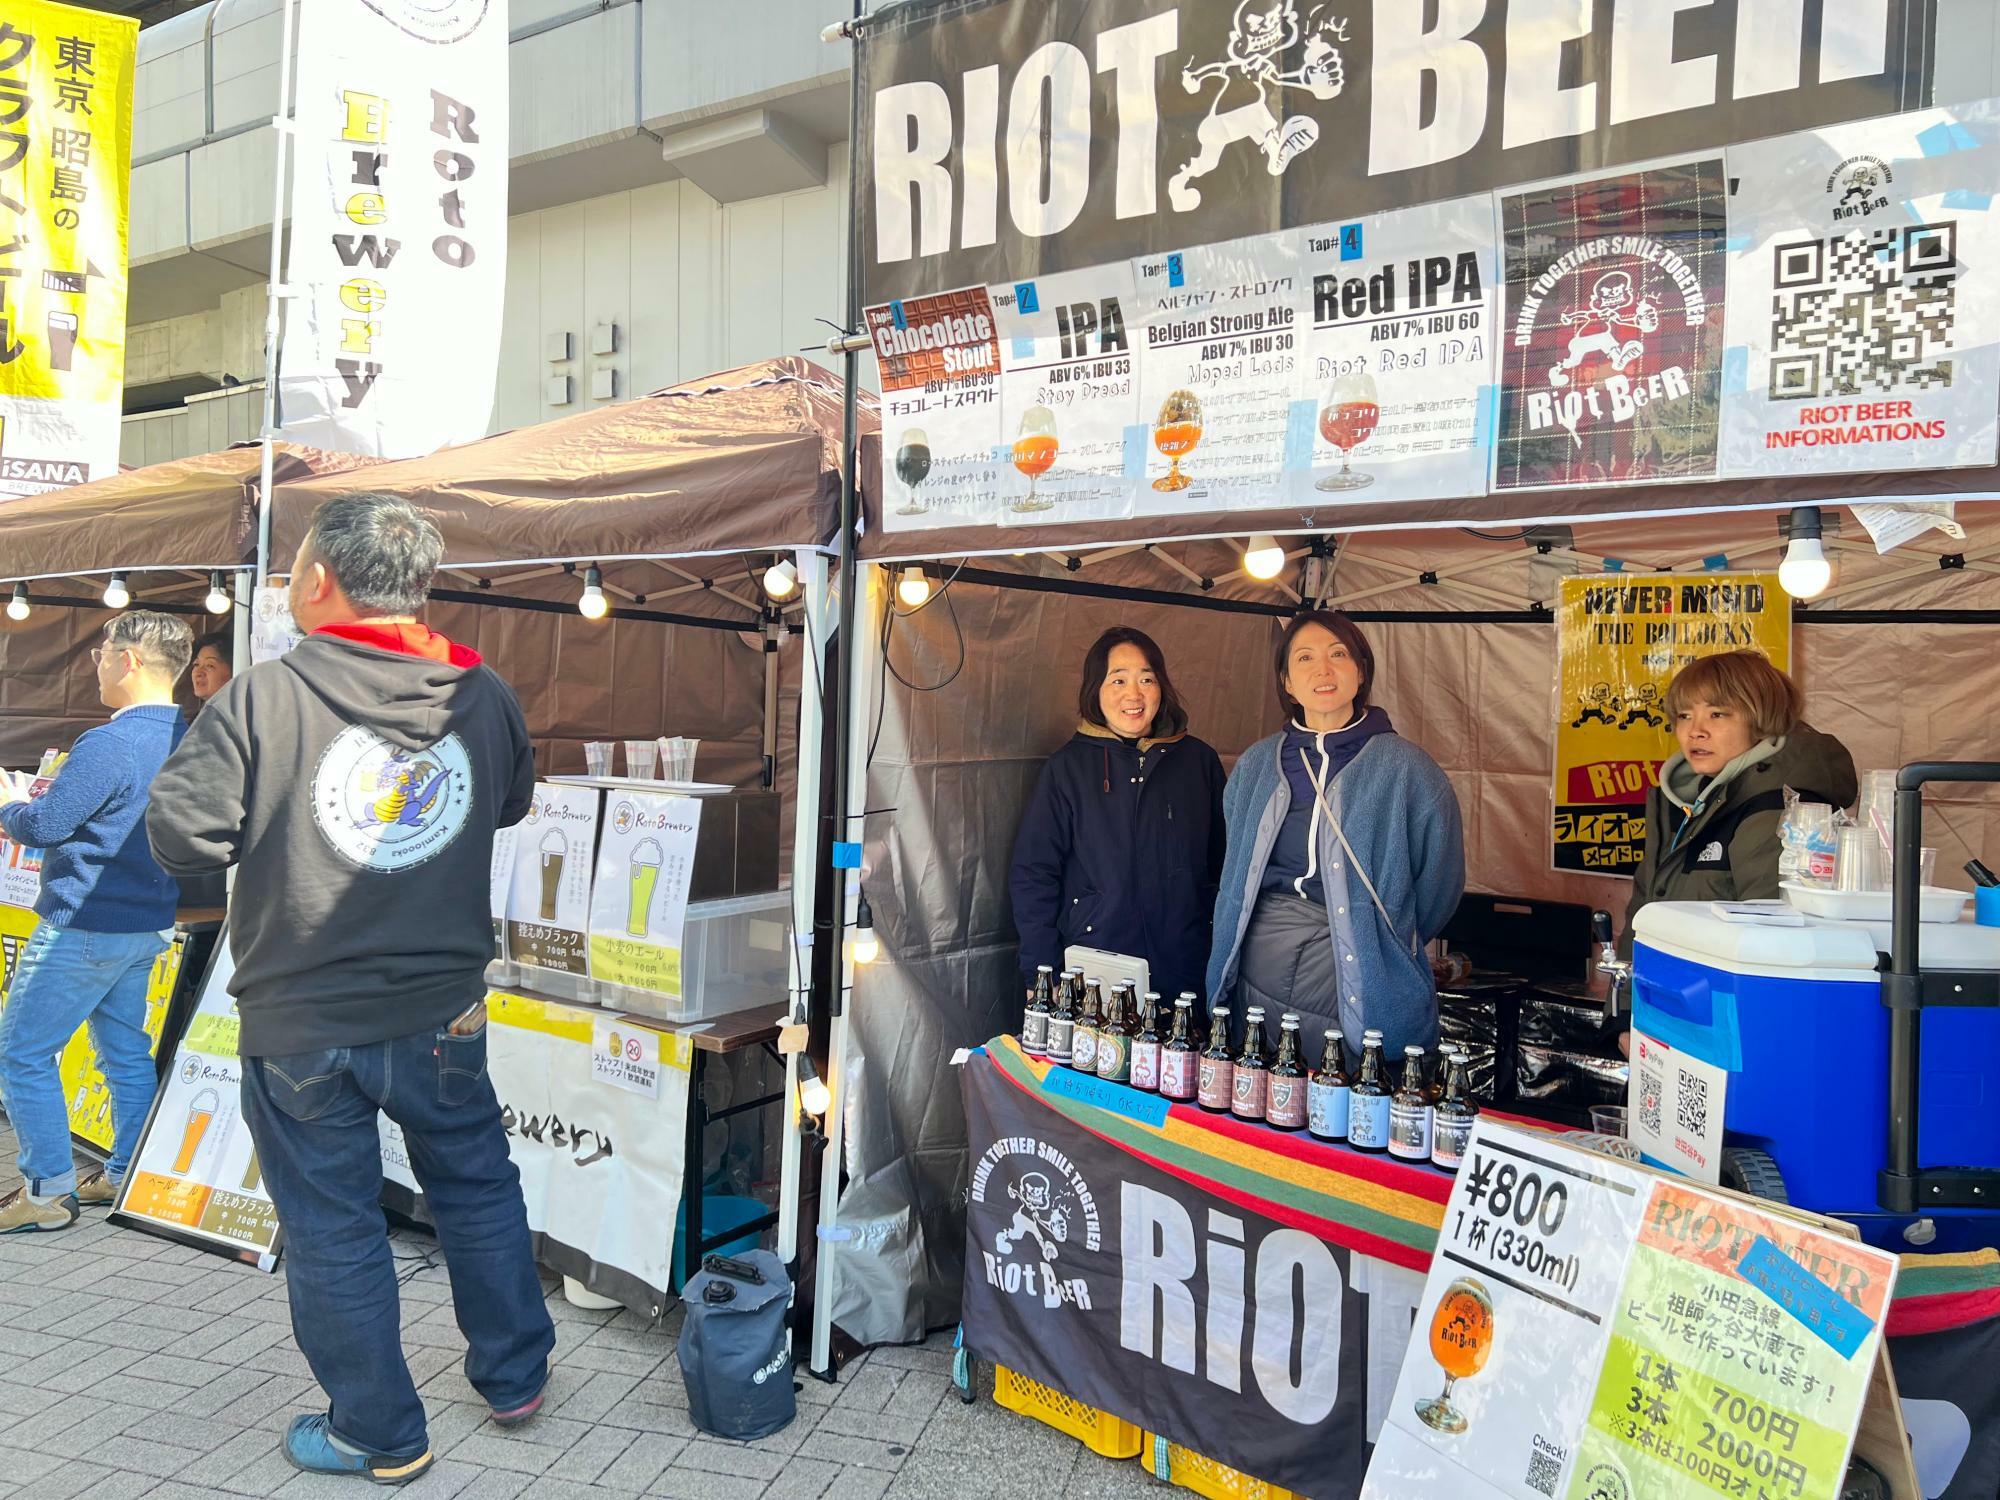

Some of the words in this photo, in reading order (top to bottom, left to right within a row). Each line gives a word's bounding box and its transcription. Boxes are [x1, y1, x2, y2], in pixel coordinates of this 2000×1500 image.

[53, 35, 96, 116] 東京
[875, 9, 1178, 264] RIOT
[50, 126, 91, 230] 昭島の
[429, 88, 480, 269] Roto
[1313, 264, 1395, 323] Red
[1407, 251, 1483, 309] IPA
[1514, 297, 1543, 347] DRINK
[1531, 238, 1610, 296] TOGETHER
[1611, 236, 1663, 263] SMILE
[1658, 248, 1705, 326] TOGETHER
[876, 313, 991, 357] Chocolate
[1055, 296, 1129, 359] IPA
[1148, 319, 1208, 344] Belgian
[1210, 311, 1264, 336] Strong
[1267, 307, 1294, 326] Ale
[1370, 323, 1401, 342] ABV
[1403, 318, 1424, 337] 7%
[1427, 315, 1455, 335] IBU
[1458, 311, 1480, 329] 60
[942, 342, 994, 373] Stout
[1201, 344, 1227, 361] ABV
[1229, 341, 1247, 357] 7%
[1249, 337, 1273, 353] IBU
[1276, 333, 1294, 350] 30
[1315, 355, 1367, 380] Riot
[1379, 347, 1427, 373] Red
[1439, 335, 1484, 365] IPA
[924, 378, 943, 394] ABV
[960, 374, 978, 389] IBU
[980, 371, 994, 386] 30
[1049, 367, 1072, 384] ABV
[1073, 365, 1091, 381] 6%
[1092, 363, 1113, 379] IBU
[1115, 360, 1131, 375] 33
[1187, 362, 1243, 388] Moped
[889, 390, 999, 416] チョコレートスタウト
[1081, 379, 1131, 400] Dread
[1799, 404, 1854, 426] RIOT
[1856, 400, 1913, 421] BEER
[1765, 419, 1946, 449] INFORMATIONS
[1585, 585, 1673, 615] NEVER
[1681, 584, 1764, 614] MIND
[1593, 622, 1634, 645] THE
[1645, 621, 1752, 645] BOLLOCKS
[518, 922, 578, 946] 控えめブラック
[605, 940, 665, 961] 小麦のエール
[634, 961, 657, 974] 700円
[207, 1015, 240, 1031] 小麦のエ
[629, 1043, 640, 1057] 20
[500, 1103, 613, 1167] ewery
[212, 1190, 275, 1216] 控えめブラック
[971, 1157, 995, 1203] DRINK
[1037, 1141, 1075, 1178] SMILE
[1070, 1171, 1101, 1252] TOGETHER
[1464, 1153, 1568, 1237] ¥800
[227, 1226, 254, 1241] 1000円
[236, 1214, 258, 1227] 700円
[1701, 1283, 1781, 1330] 小田急線
[1635, 1354, 1682, 1393] 1本
[1711, 1386, 1800, 1452] 700円
[1532, 1433, 1568, 1461] Check!
[1625, 1386, 1671, 1427] 3本
[1697, 1422, 1808, 1497] 2000円
